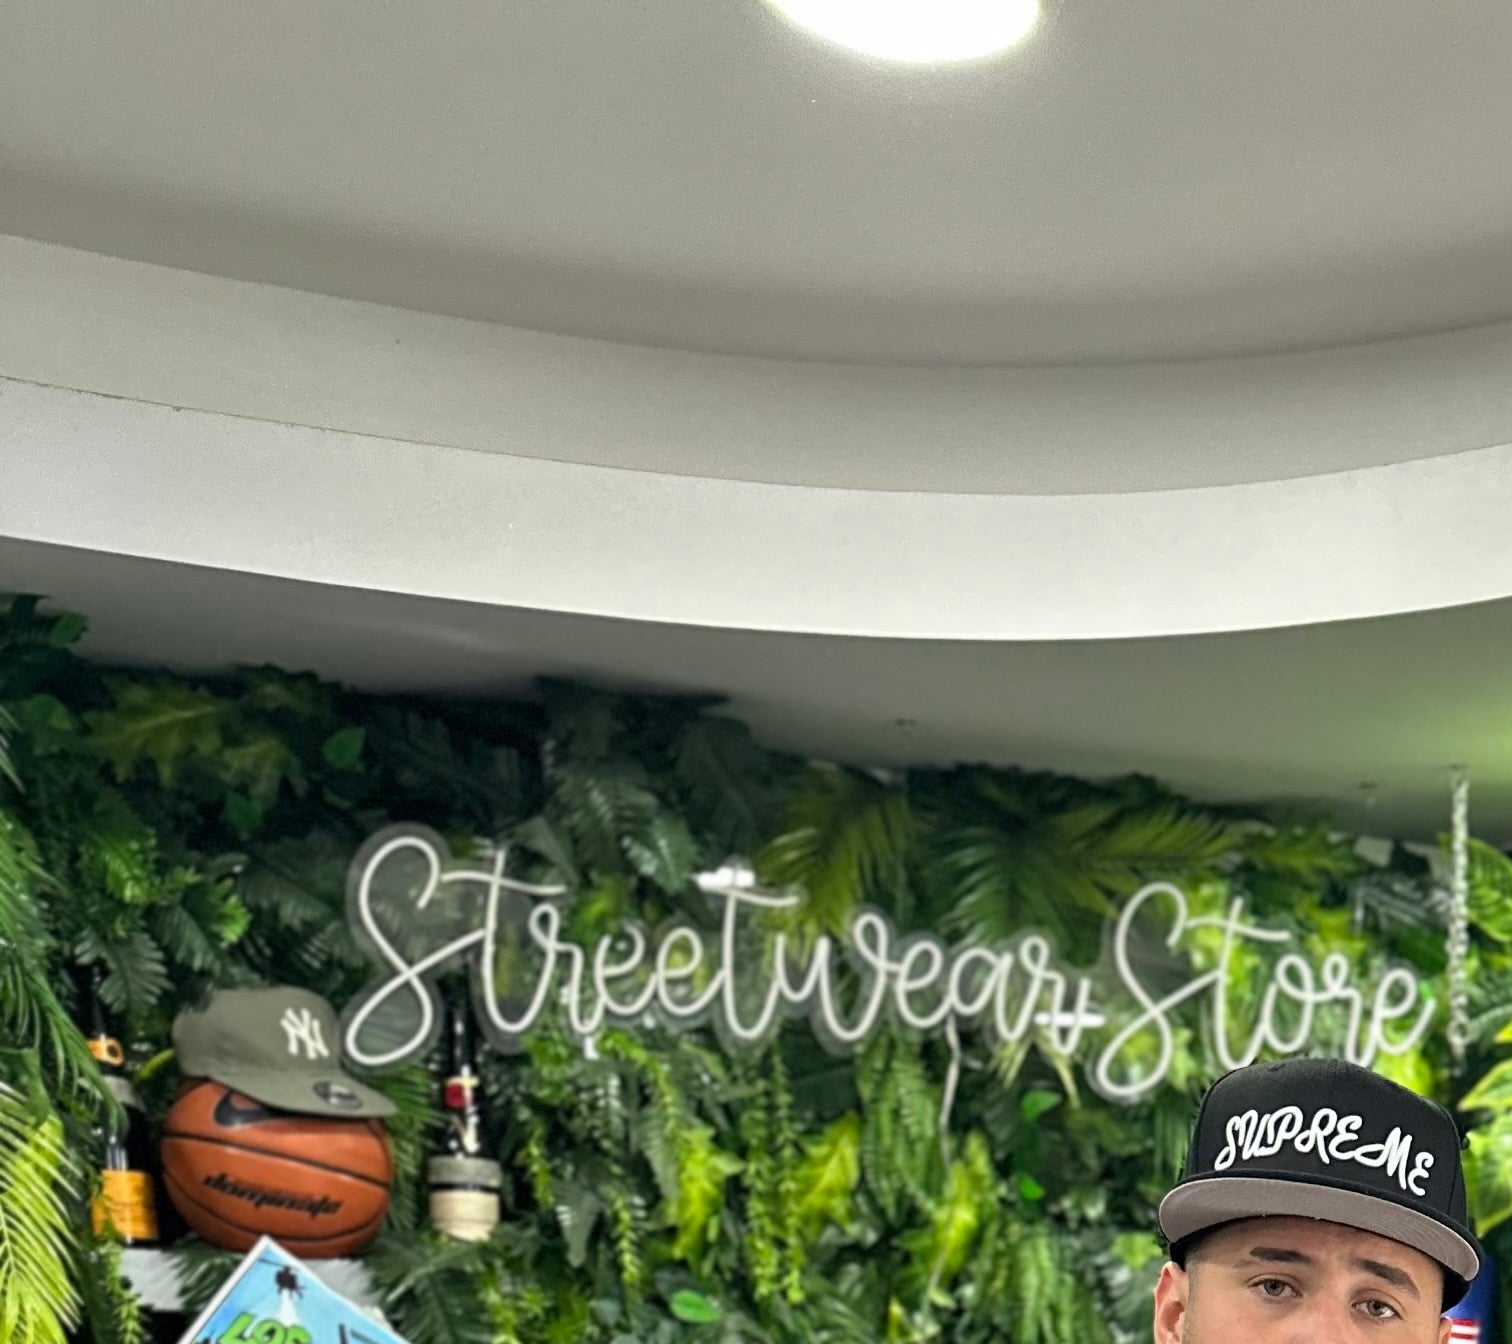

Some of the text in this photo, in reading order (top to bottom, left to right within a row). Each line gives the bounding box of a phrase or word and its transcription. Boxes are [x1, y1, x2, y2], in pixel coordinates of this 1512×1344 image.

[347, 835, 1436, 1100] Streetwear Store
[1214, 1105, 1435, 1197] SUPREME
